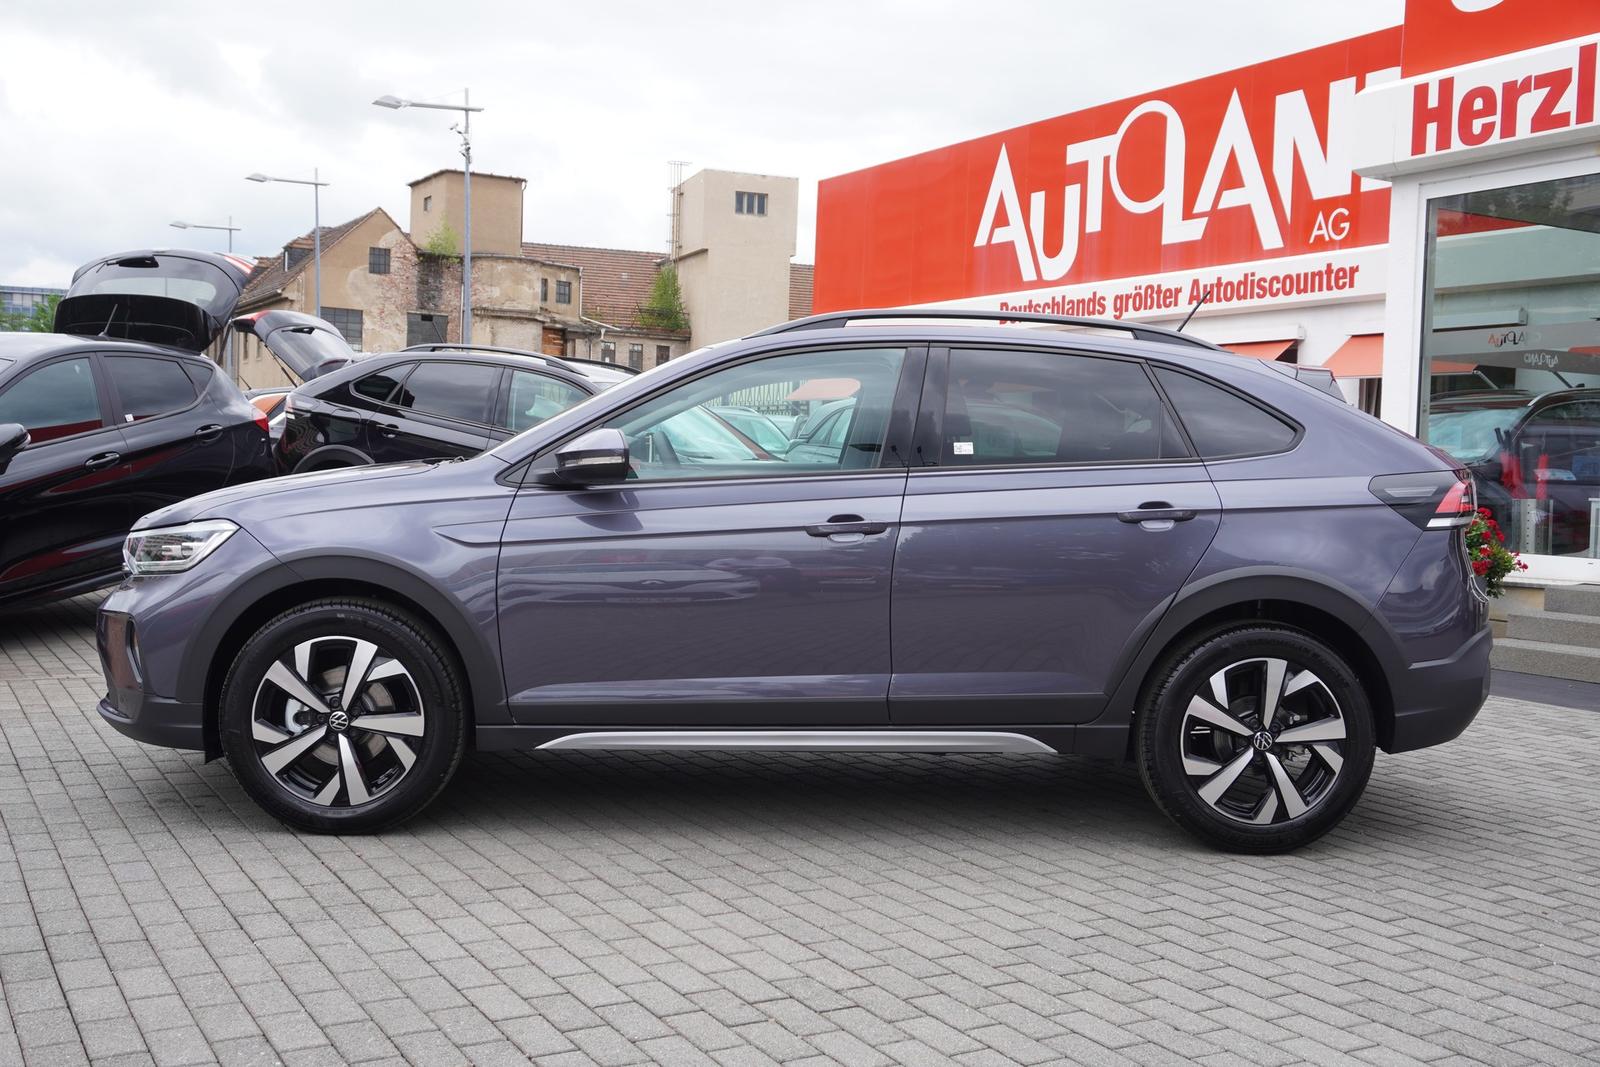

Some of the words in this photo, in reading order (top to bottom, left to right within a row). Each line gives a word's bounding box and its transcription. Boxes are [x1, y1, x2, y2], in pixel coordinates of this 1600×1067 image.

[973, 66, 1401, 283] AUTOLAN
[1309, 207, 1351, 244] AG
[1113, 284, 1183, 320] größter
[1187, 262, 1360, 306] Autodiscounter
